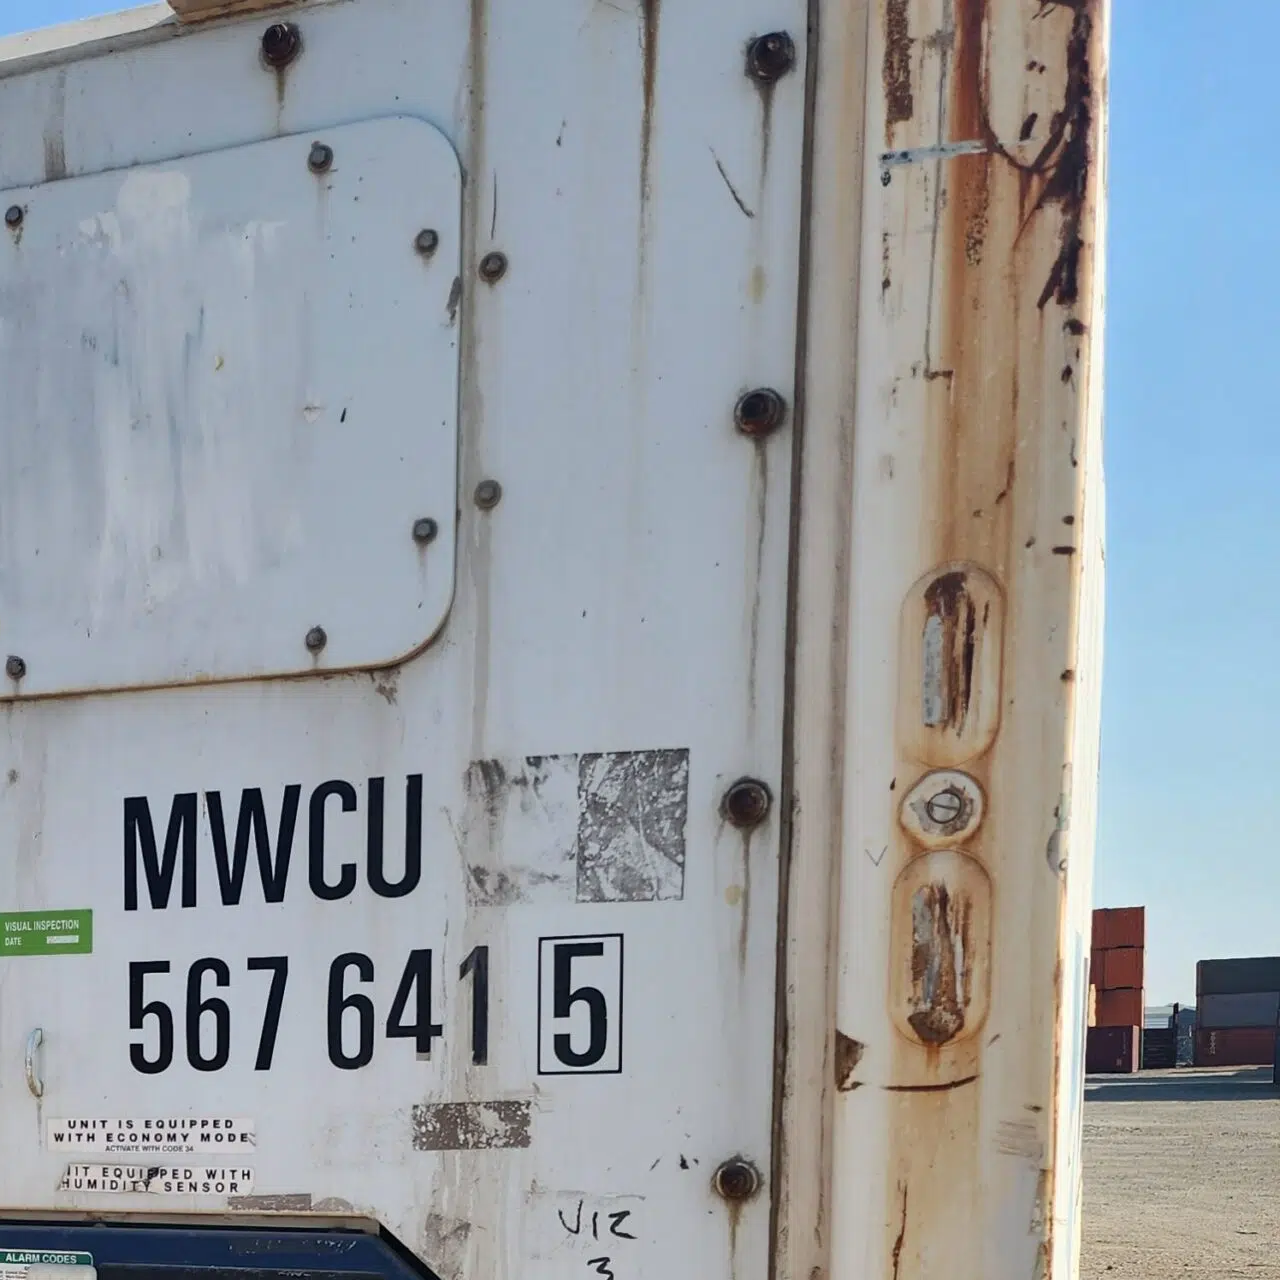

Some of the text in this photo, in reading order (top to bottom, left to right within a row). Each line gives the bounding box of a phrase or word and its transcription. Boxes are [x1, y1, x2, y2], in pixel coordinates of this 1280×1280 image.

[123, 774, 423, 911] MWCU
[5, 919, 79, 931] VISUAL INSPECTION
[5, 936, 22, 946] DATE
[129, 942, 608, 1075] 567 641 5
[68, 1119, 234, 1130] UNIT IS EQUIPPED
[53, 1132, 248, 1143] WITH ECONOMY MODE
[141, 1145, 161, 1153] WITH
[162, 1145, 184, 1153] CODE
[185, 1145, 194, 1153] 34
[205, 1168, 251, 1181] WITH
[61, 1178, 239, 1193] HUMIDITY SENSOR
[5, 1252, 77, 1264] ALARM CODES
